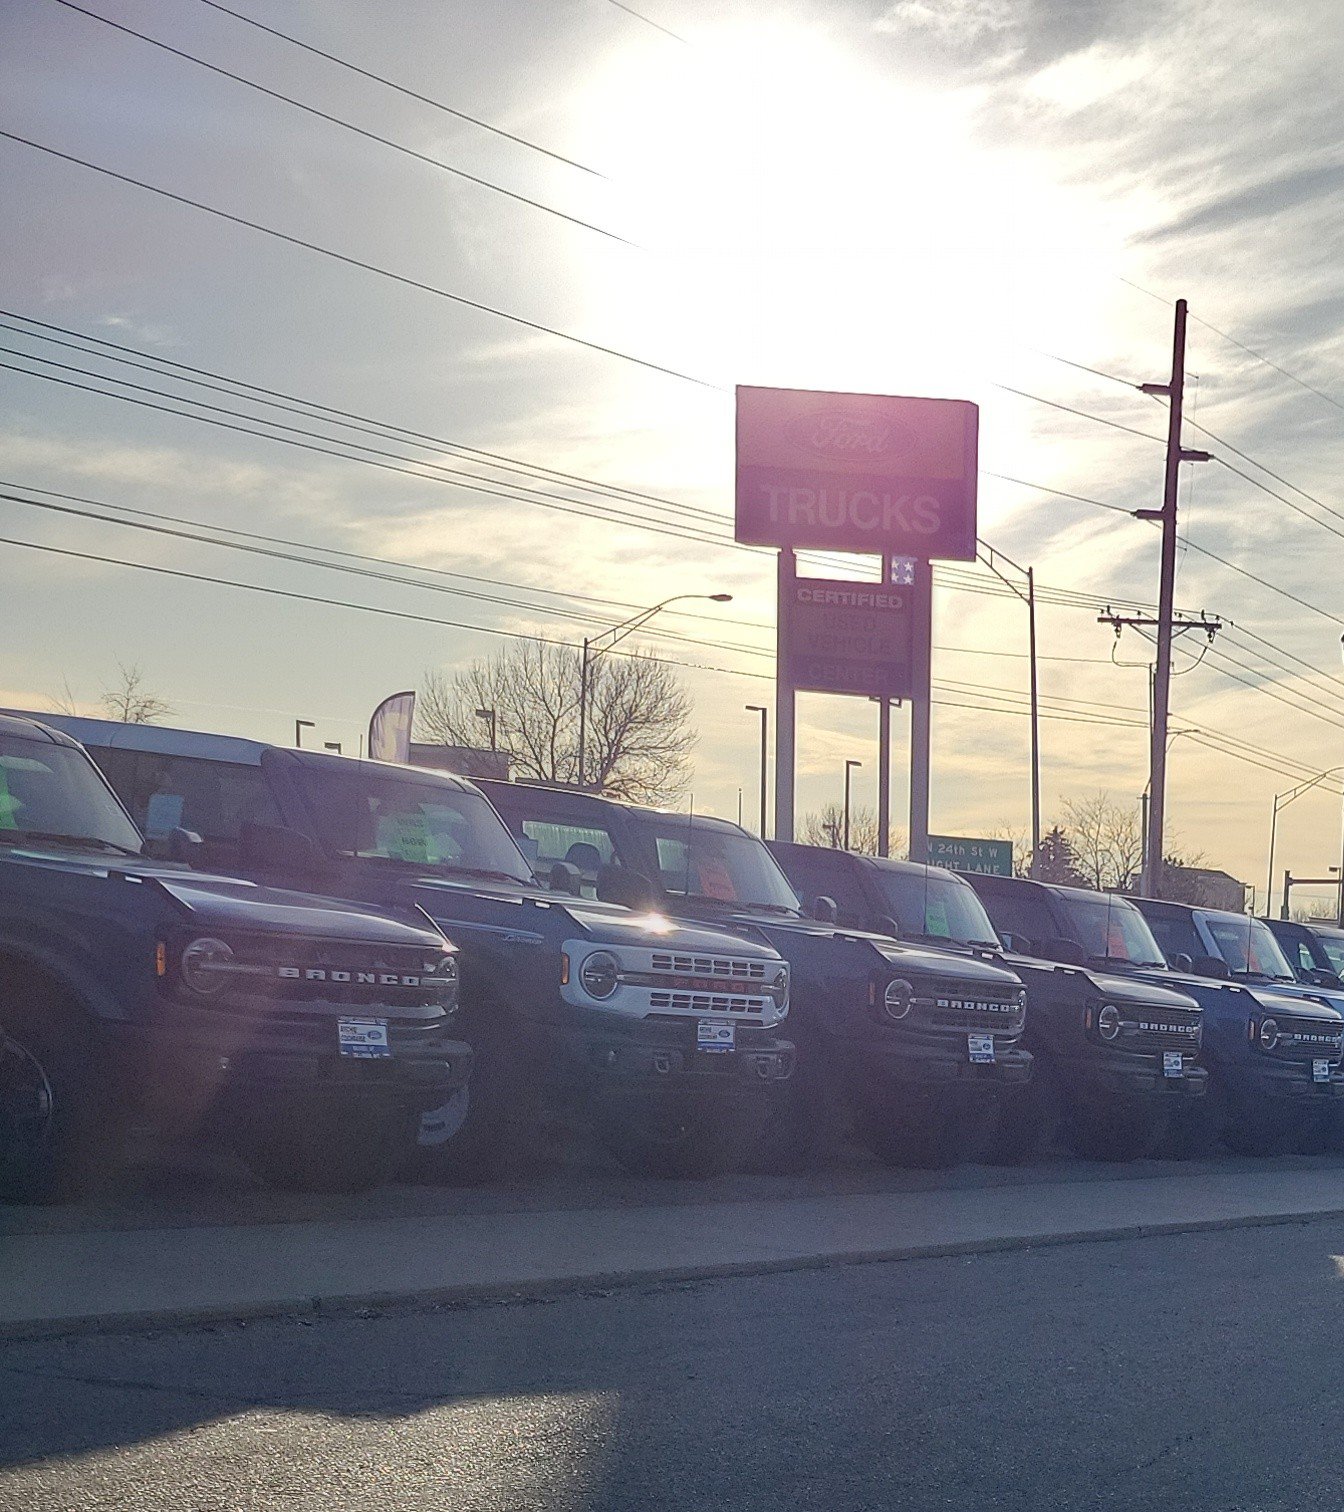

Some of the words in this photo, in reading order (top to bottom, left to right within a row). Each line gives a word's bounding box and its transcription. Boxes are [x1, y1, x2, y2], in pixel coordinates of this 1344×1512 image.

[811, 416, 890, 454] Ford
[761, 482, 941, 535] TRUCKS
[796, 588, 904, 610] CERTIFIED
[809, 663, 889, 685] CENTER
[938, 843, 966, 856] 24th
[971, 846, 983, 858] St
[989, 847, 998, 859] W
[967, 863, 1000, 875] LANE
[278, 966, 420, 987] BRONCO
[937, 999, 1010, 1013] BRONCO
